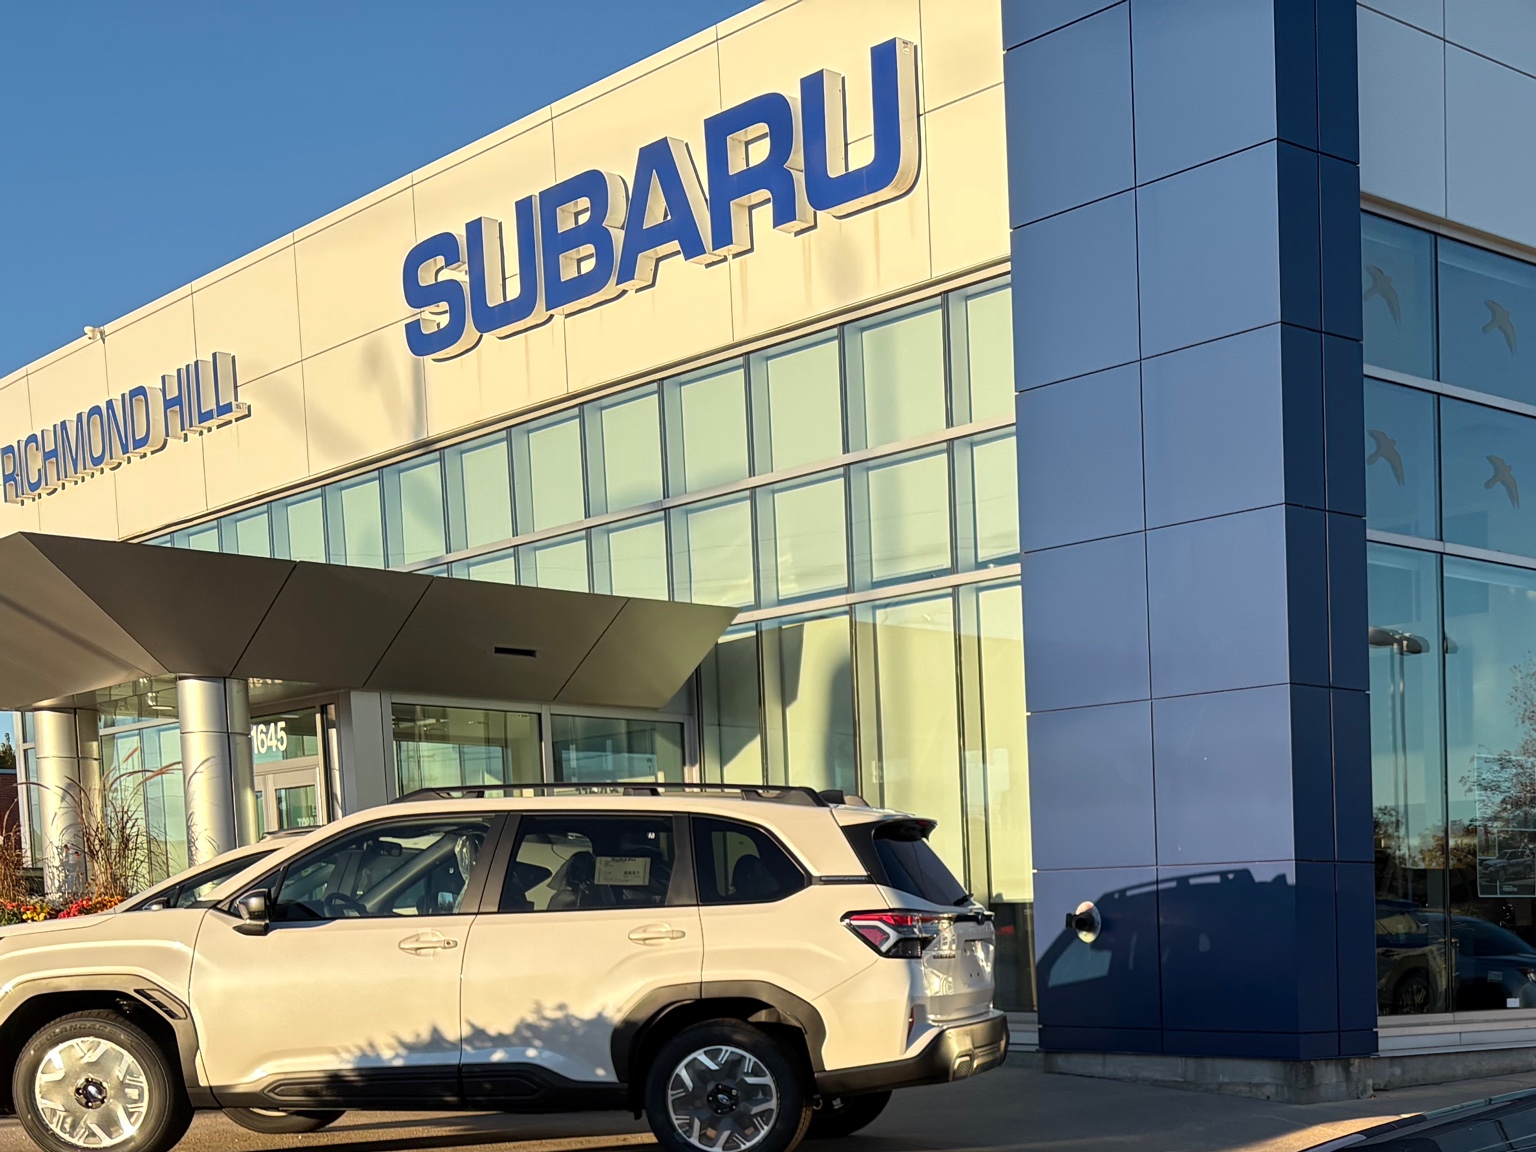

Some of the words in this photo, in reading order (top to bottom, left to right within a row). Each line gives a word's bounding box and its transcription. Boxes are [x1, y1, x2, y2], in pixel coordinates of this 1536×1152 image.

[403, 37, 915, 358] SUBARU
[0, 385, 157, 503] RICHMOND
[161, 351, 238, 438] HILL
[251, 721, 287, 754] 1645
